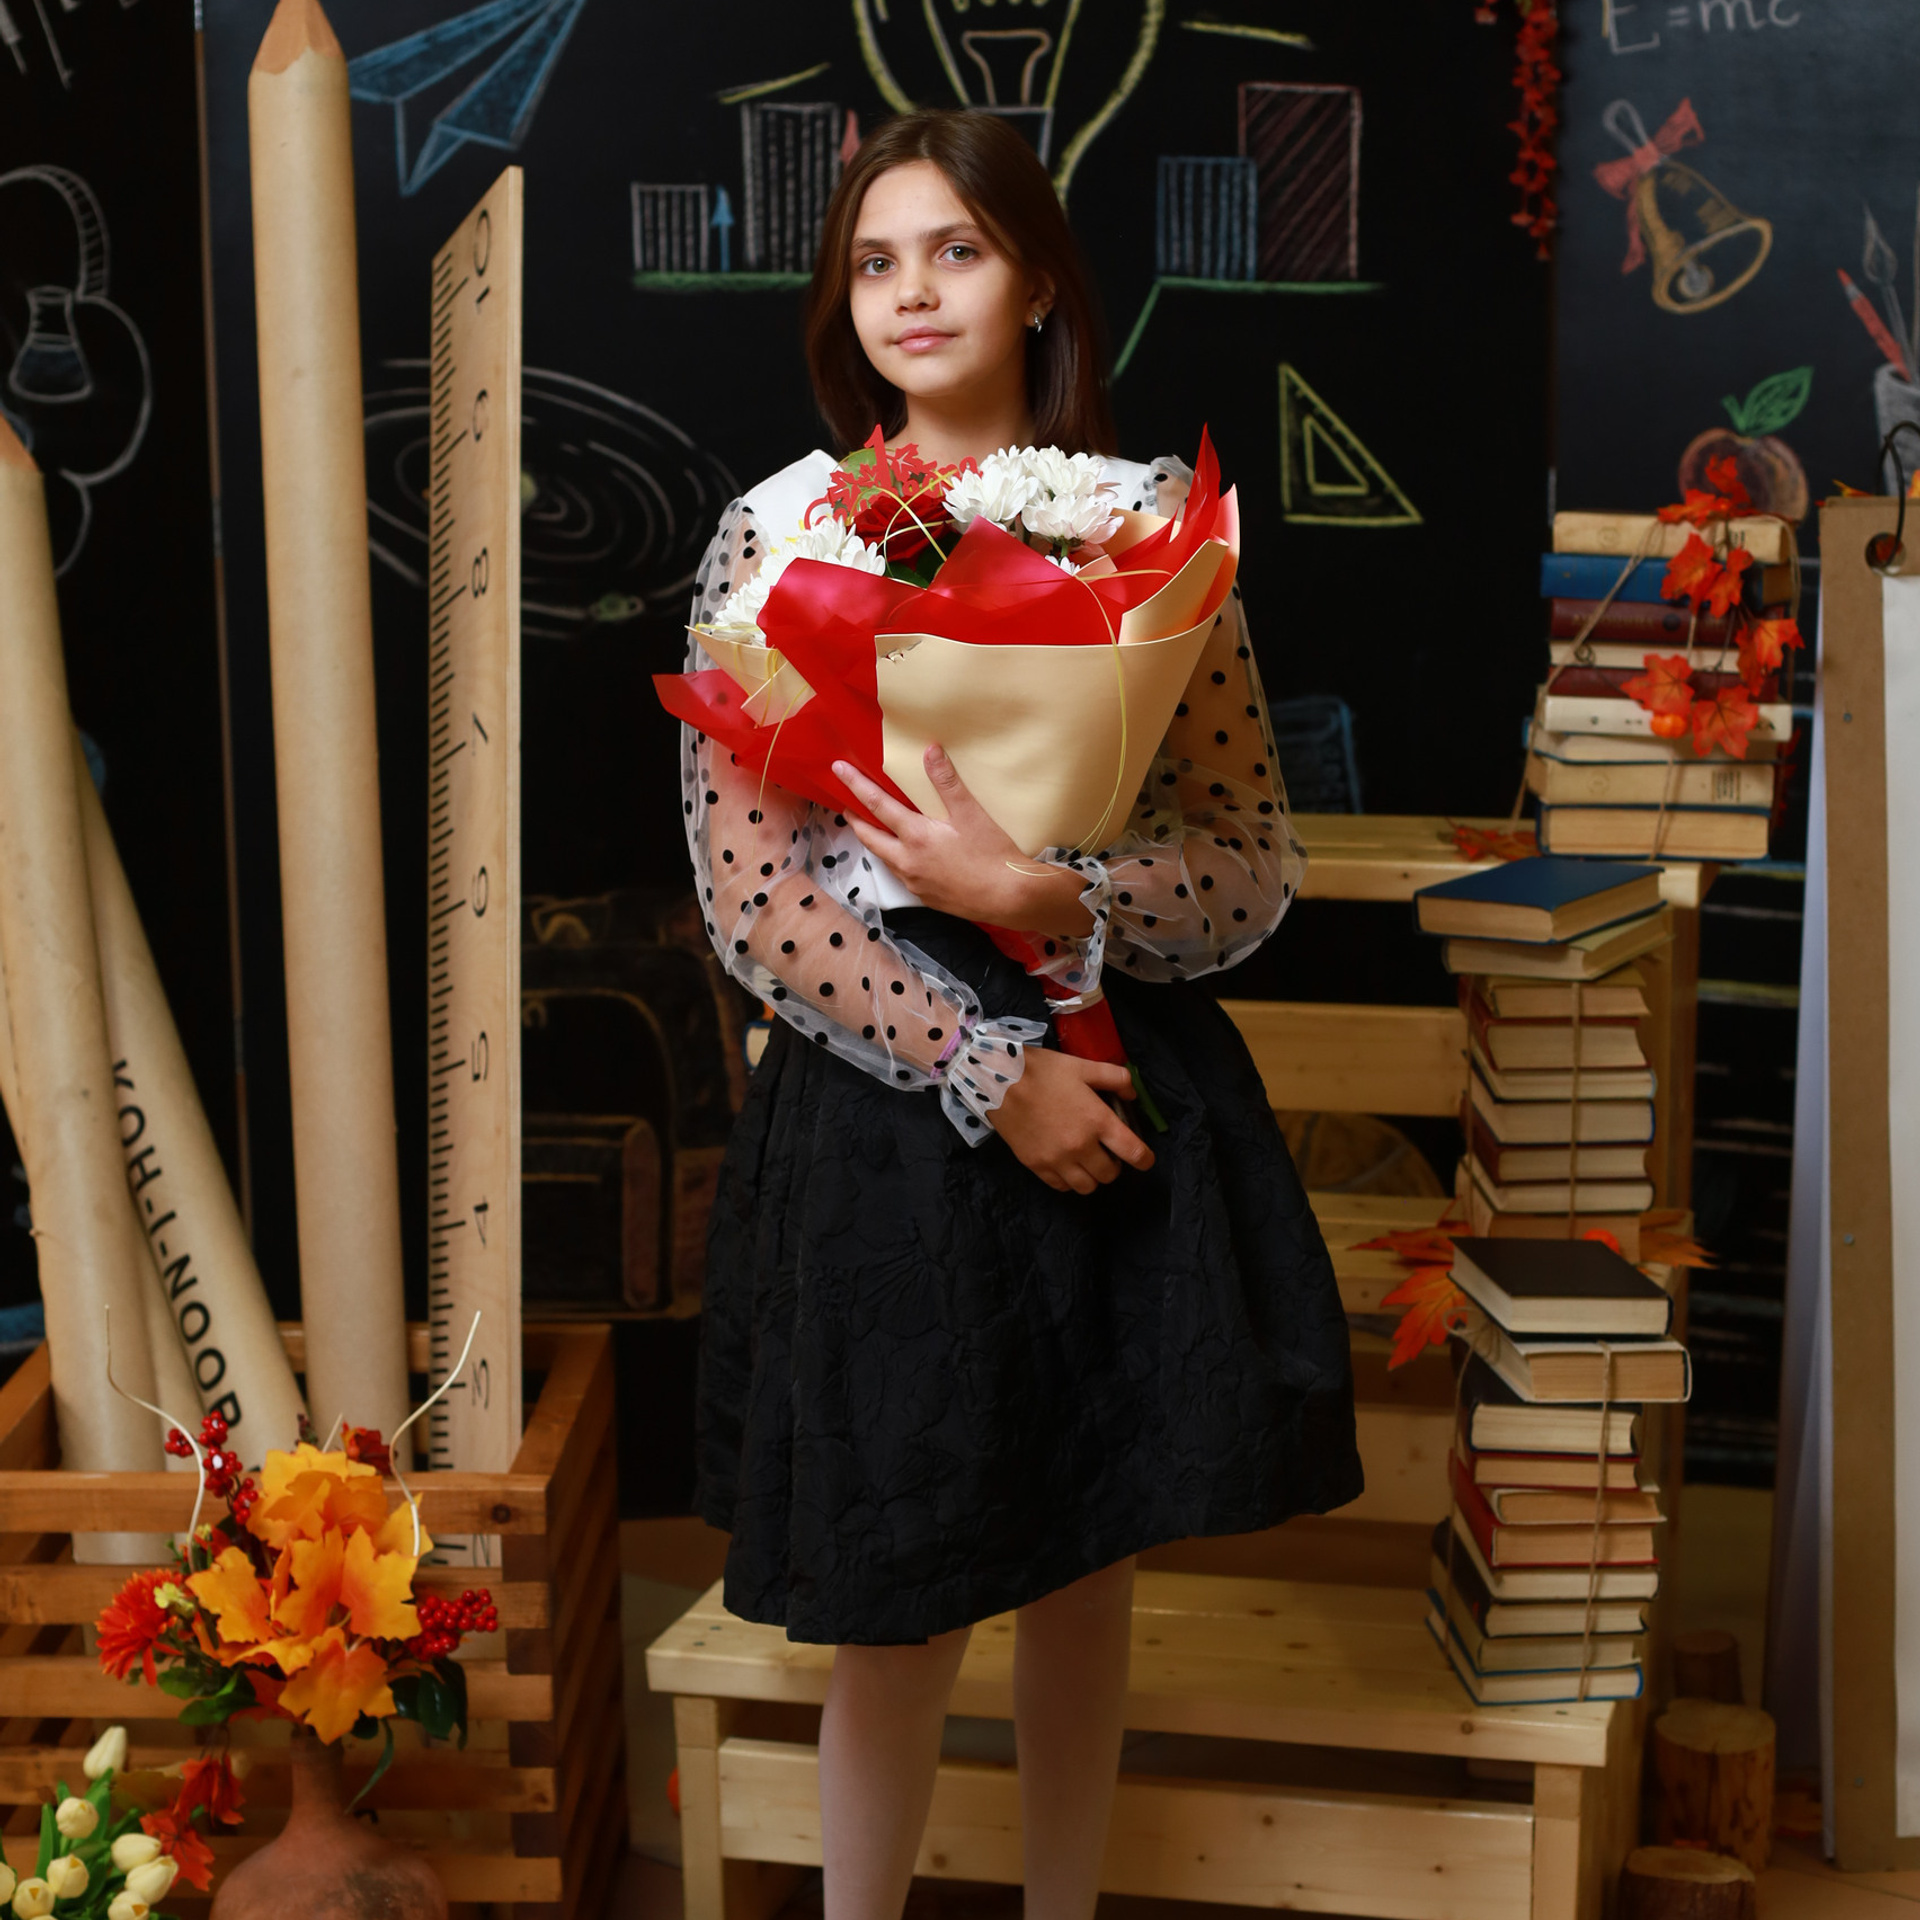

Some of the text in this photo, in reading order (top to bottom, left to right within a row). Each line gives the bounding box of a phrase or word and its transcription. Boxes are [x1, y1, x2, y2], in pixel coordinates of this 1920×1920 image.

[471, 546, 489, 599] 8
[471, 865, 489, 918] 6
[472, 1030, 489, 1082] 5
[473, 1194, 489, 1249] 4
[471, 1358, 490, 1410] 3
